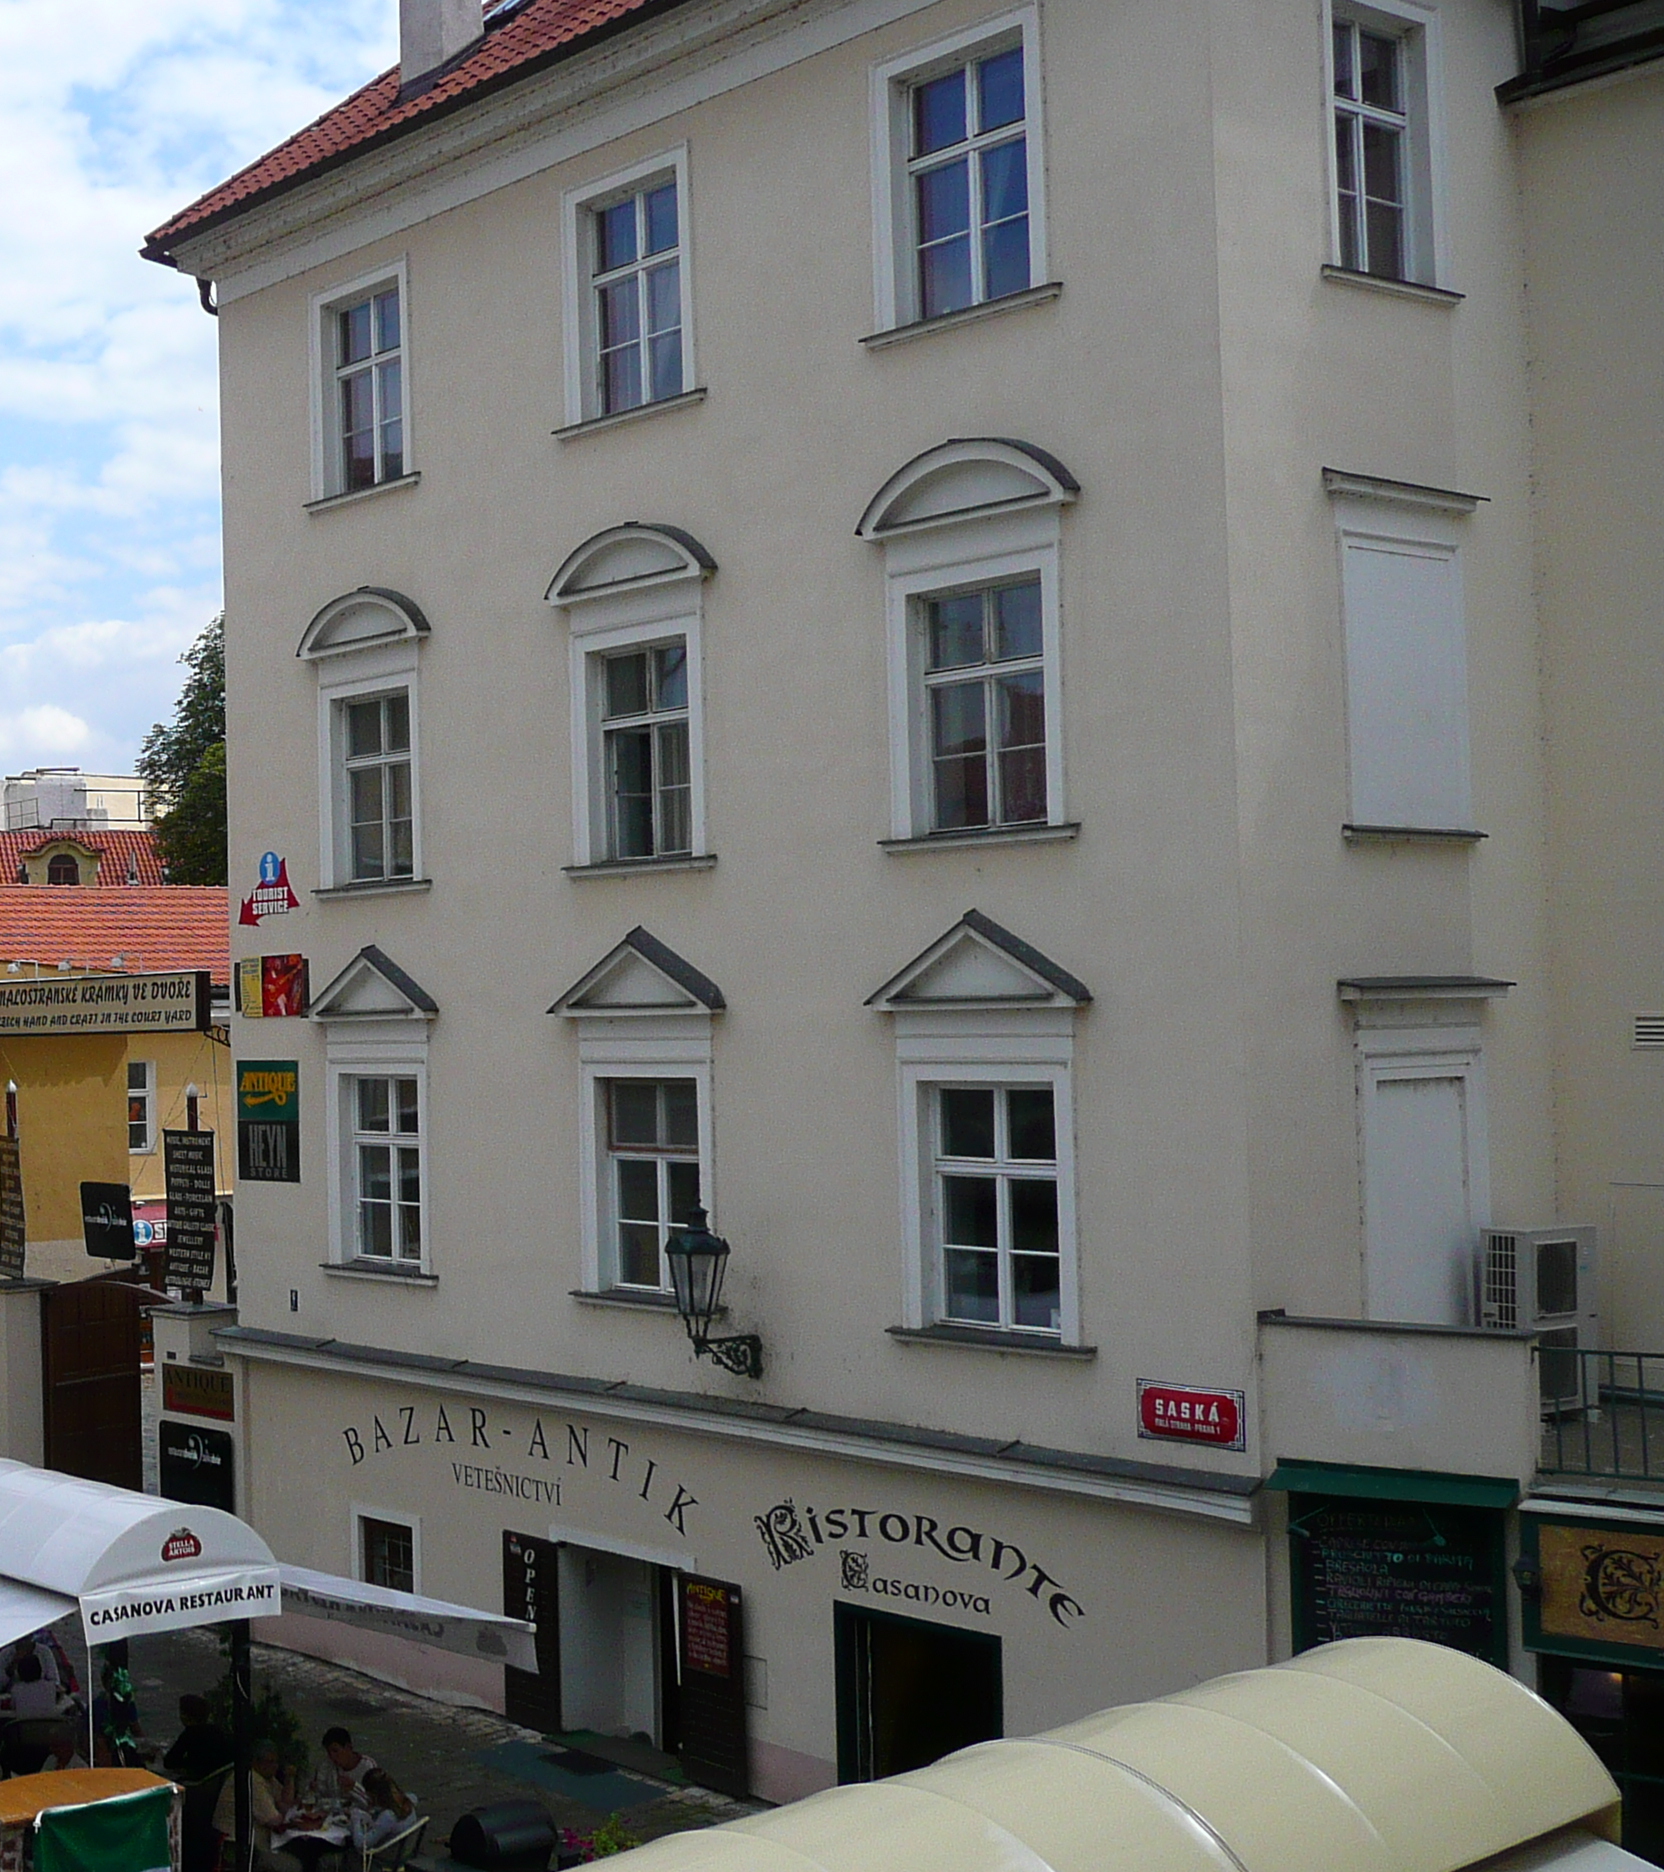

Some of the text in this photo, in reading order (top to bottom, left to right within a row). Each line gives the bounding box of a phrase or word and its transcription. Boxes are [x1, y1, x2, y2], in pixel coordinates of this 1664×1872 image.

[252, 886, 289, 901] TOURIST
[252, 900, 289, 915] SERVICE
[80, 980, 129, 1006] KRÁMKY
[132, 983, 148, 1001] VE
[150, 977, 192, 1001] DVOŘE
[22, 1013, 49, 1029] HAND
[49, 1013, 69, 1028] AND
[69, 1012, 99, 1027] CRAFT
[100, 1012, 112, 1025] IN
[112, 1011, 130, 1024] THE
[131, 1010, 163, 1024] COURT
[163, 1009, 192, 1026] YARD
[240, 1071, 296, 1094] ANTIQUE
[248, 1124, 287, 1168] HEYN
[249, 1167, 288, 1179] STORE
[166, 1367, 230, 1395] ANTIQUE
[1155, 1398, 1220, 1423] SASKÁ
[451, 1461, 562, 1507] VETEŠNICTVÍ
[167, 1538, 196, 1549] STELLA
[167, 1546, 196, 1557] ARTOIS
[523, 1547, 538, 1621] OPEN
[839, 1549, 991, 1616] Casanova
[89, 1598, 176, 1626] CASANOVA
[179, 1584, 275, 1611] RESTAURANT
